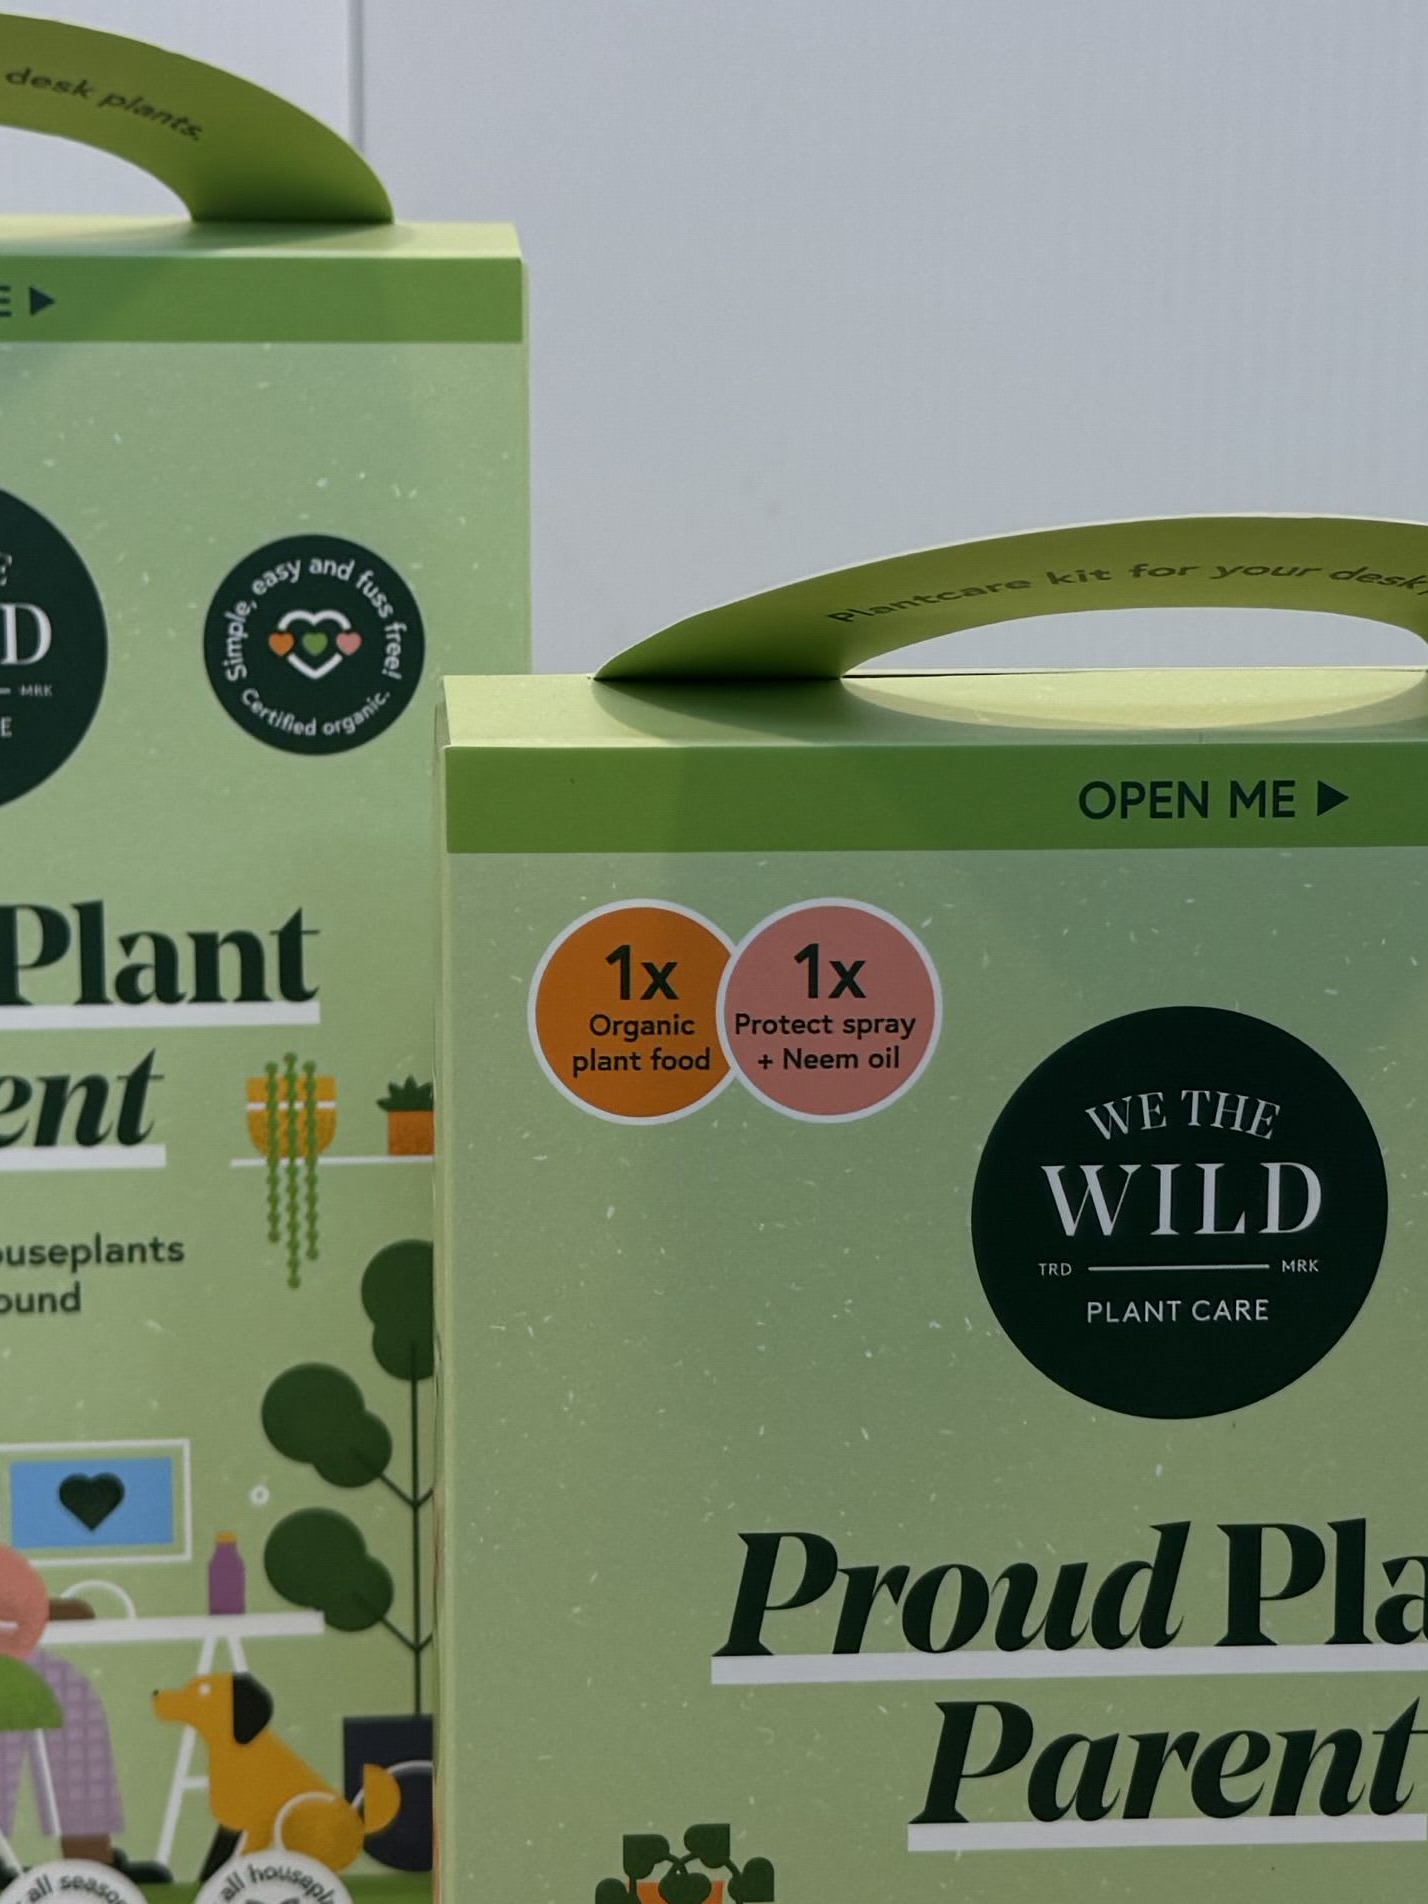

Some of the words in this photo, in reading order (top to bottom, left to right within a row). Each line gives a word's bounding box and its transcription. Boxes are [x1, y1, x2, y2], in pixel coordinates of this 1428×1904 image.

[6, 68, 91, 98] desk
[826, 578, 1033, 623] Plantcare
[1045, 568, 1112, 586] kit
[1128, 563, 1199, 579] for
[1210, 565, 1323, 579] your
[1329, 566, 1428, 589] desk
[223, 600, 257, 681] Simple,
[252, 559, 301, 595] easy
[309, 557, 355, 581] and
[356, 571, 393, 618] fuss
[382, 622, 406, 680] free!
[20, 685, 52, 697] MRK
[242, 689, 316, 736] Certified
[322, 691, 390, 736] organic.
[1079, 780, 1209, 820] OPEN
[1230, 780, 1295, 818] ME
[606, 944, 679, 1000] 1x
[794, 943, 866, 999] 1x
[589, 1014, 695, 1041] Organic
[736, 1013, 833, 1035] Protect
[843, 1017, 916, 1039] spray
[573, 1049, 642, 1078] plant
[650, 1048, 711, 1071] food
[783, 1048, 858, 1069] Neem
[869, 1046, 900, 1068] oil
[1085, 1092, 1167, 1140] WE
[1181, 1090, 1281, 1139] THE
[1041, 1162, 1322, 1236] WILD
[1038, 1263, 1072, 1276] TRD
[1282, 1260, 1319, 1272] MRK
[1088, 1301, 1181, 1323] PLANT
[1192, 1299, 1268, 1321] CARE
[713, 1520, 1191, 1656] Proud
[910, 1696, 1428, 1825] Parent
[29, 1874, 53, 1904] all
[222, 1872, 245, 1904] all
